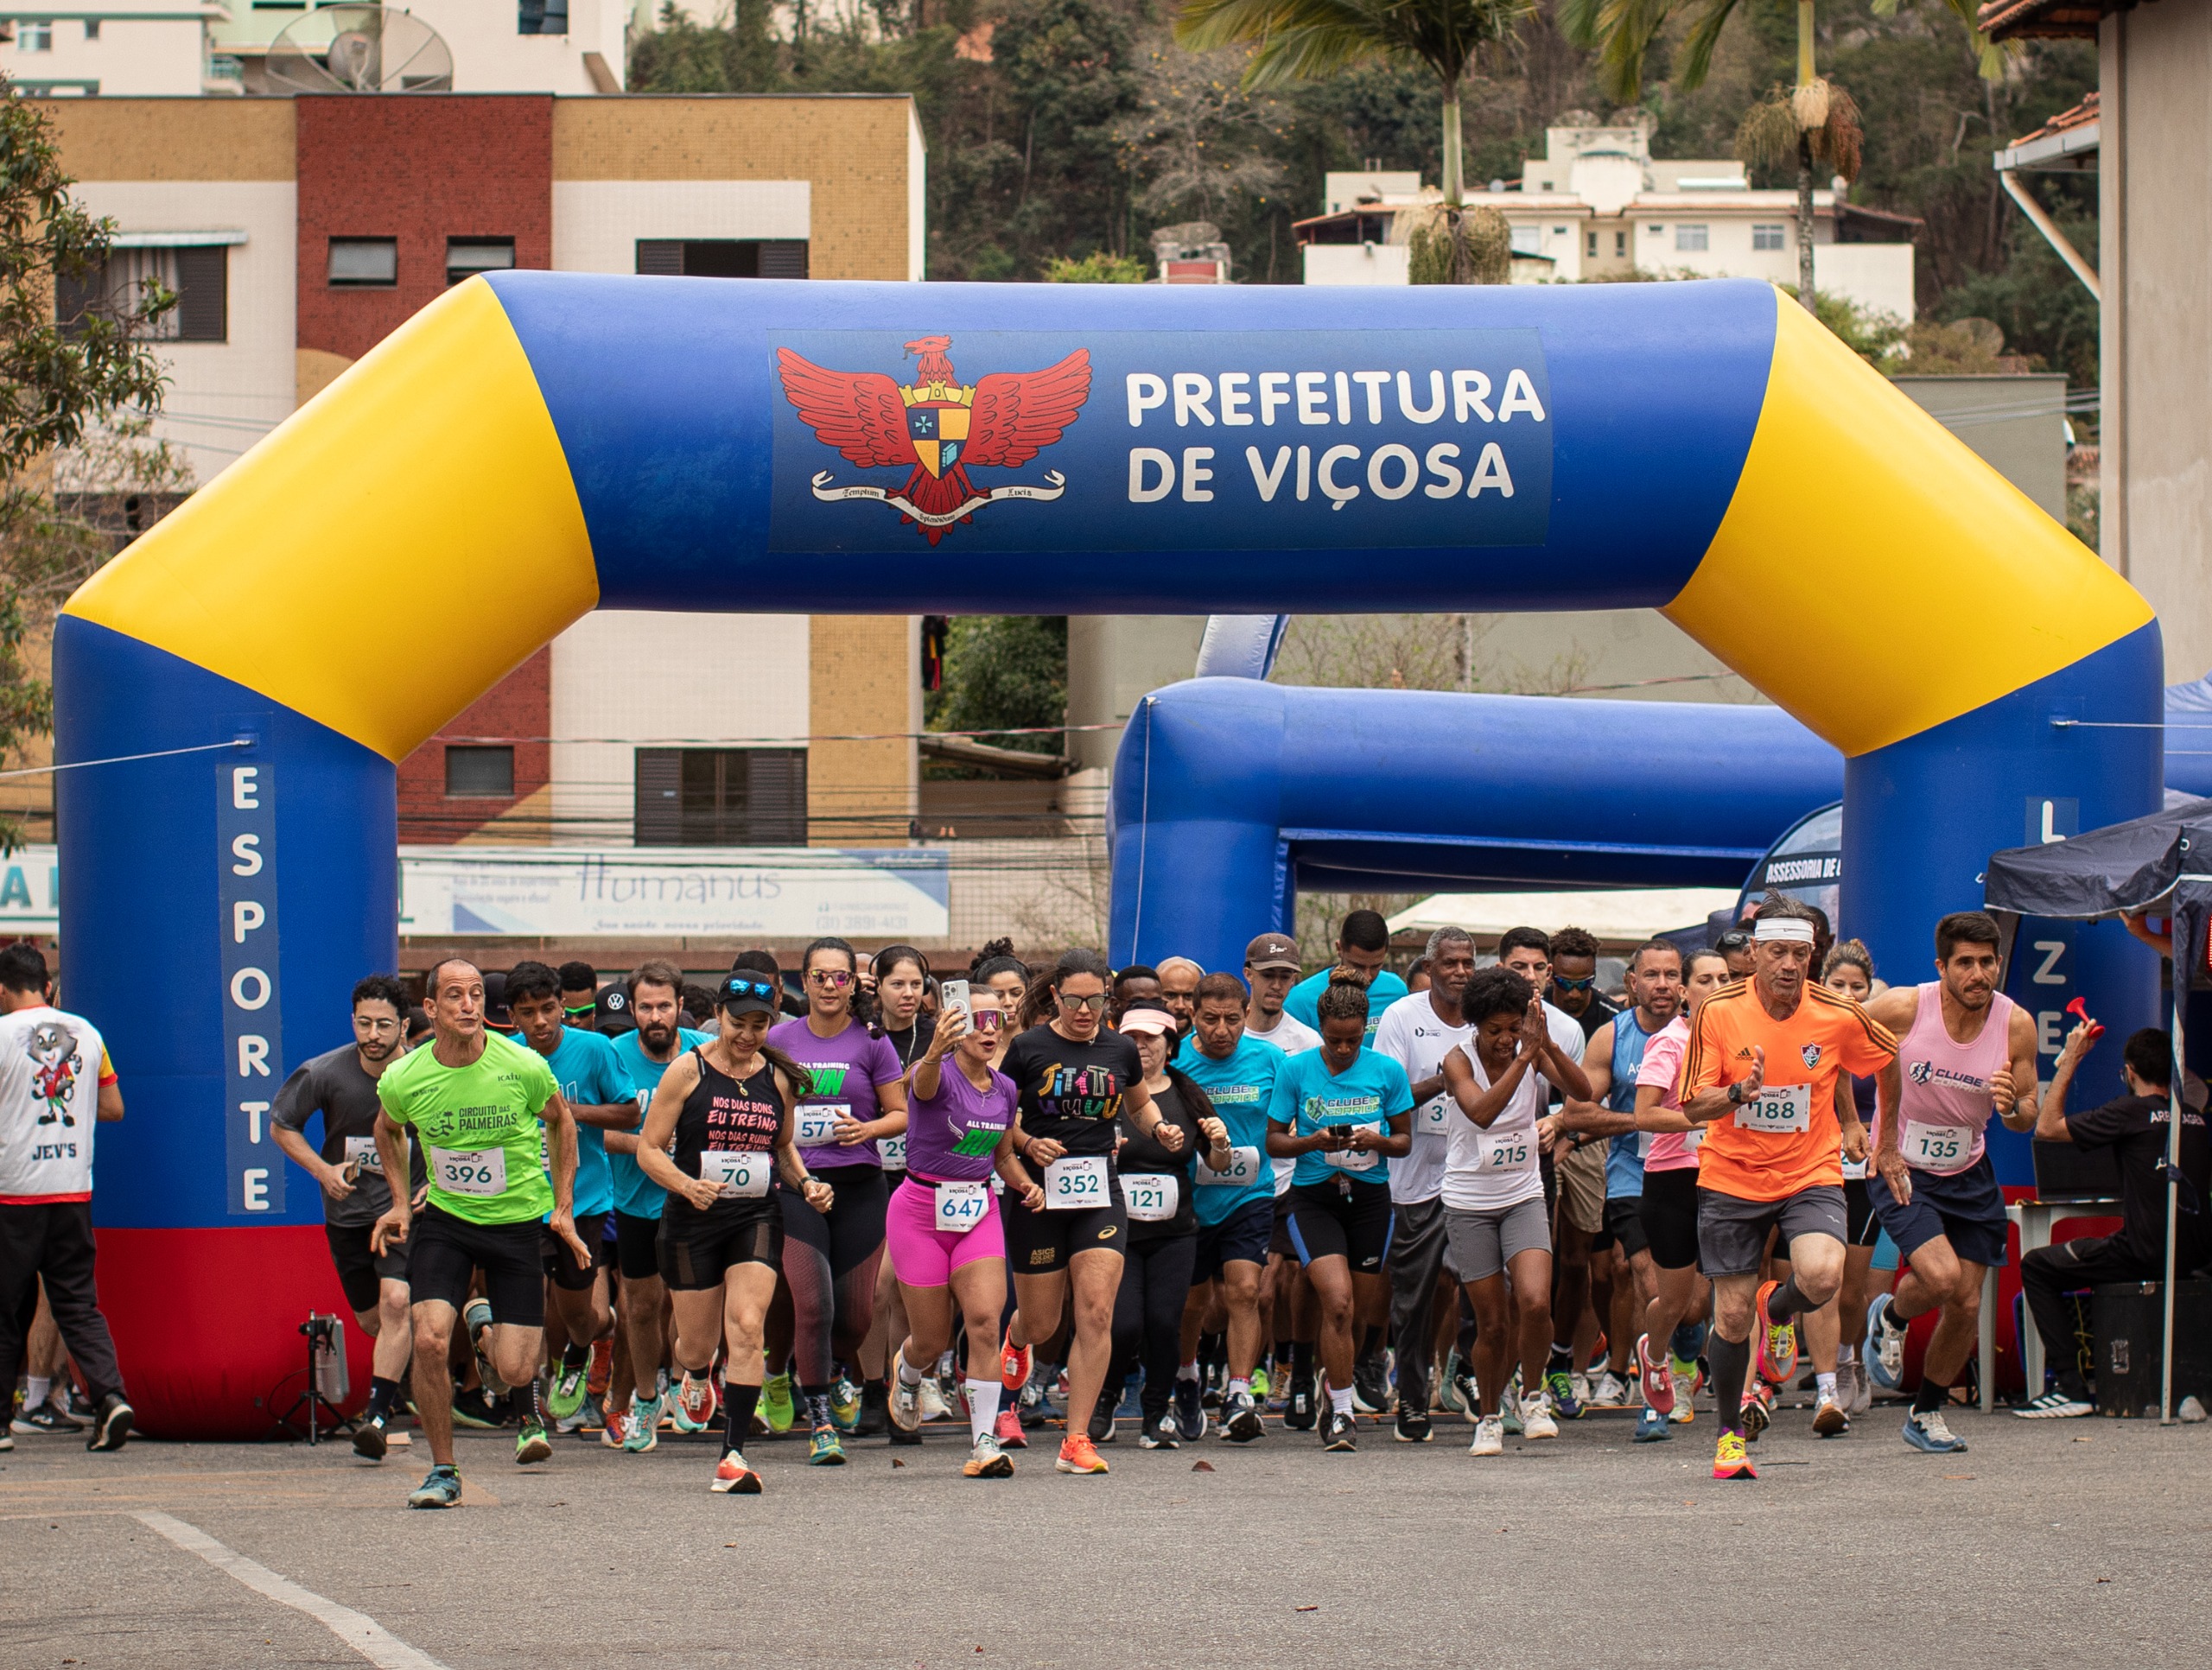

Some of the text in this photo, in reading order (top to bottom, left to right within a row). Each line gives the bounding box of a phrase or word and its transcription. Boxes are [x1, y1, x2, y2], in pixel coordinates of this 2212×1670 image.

[1126, 369, 1546, 428] PREFEITURA
[1128, 441, 1515, 511] DE VIÇOSA
[842, 487, 880, 498] Templum
[1007, 487, 1033, 498] Lucis
[576, 854, 782, 904] Humanus
[1765, 857, 1838, 884] ASSESSORIA DE
[2032, 800, 2067, 1113] LZE
[230, 766, 272, 1210] ESPORTE
[812, 1062, 850, 1070] TRAINING
[799, 1068, 847, 1096] UN
[1936, 1068, 1984, 1088] CLUBE
[1206, 1085, 1249, 1095] CLUBE
[713, 1096, 730, 1109] NOS
[731, 1099, 750, 1112] DIAS
[1327, 1096, 1370, 1108] CLUBE
[1753, 1102, 1795, 1119] 188
[459, 1105, 511, 1118] CIRCUITO DAS
[707, 1109, 727, 1125] EU
[459, 1113, 518, 1131] PALMEIRAS
[966, 1120, 980, 1128] ALL
[709, 1129, 727, 1140] NOS
[728, 1131, 747, 1142] DIAS
[32, 1142, 77, 1161] JEV'S
[1492, 1146, 1528, 1166] 215
[1920, 1139, 1960, 1158] 135
[445, 1165, 492, 1184] 396
[721, 1168, 750, 1186] 70
[1058, 1174, 1099, 1195] 352
[942, 1198, 983, 1217] 647
[1129, 1191, 1163, 1208] 121
[1032, 1247, 1056, 1255] ASICS
